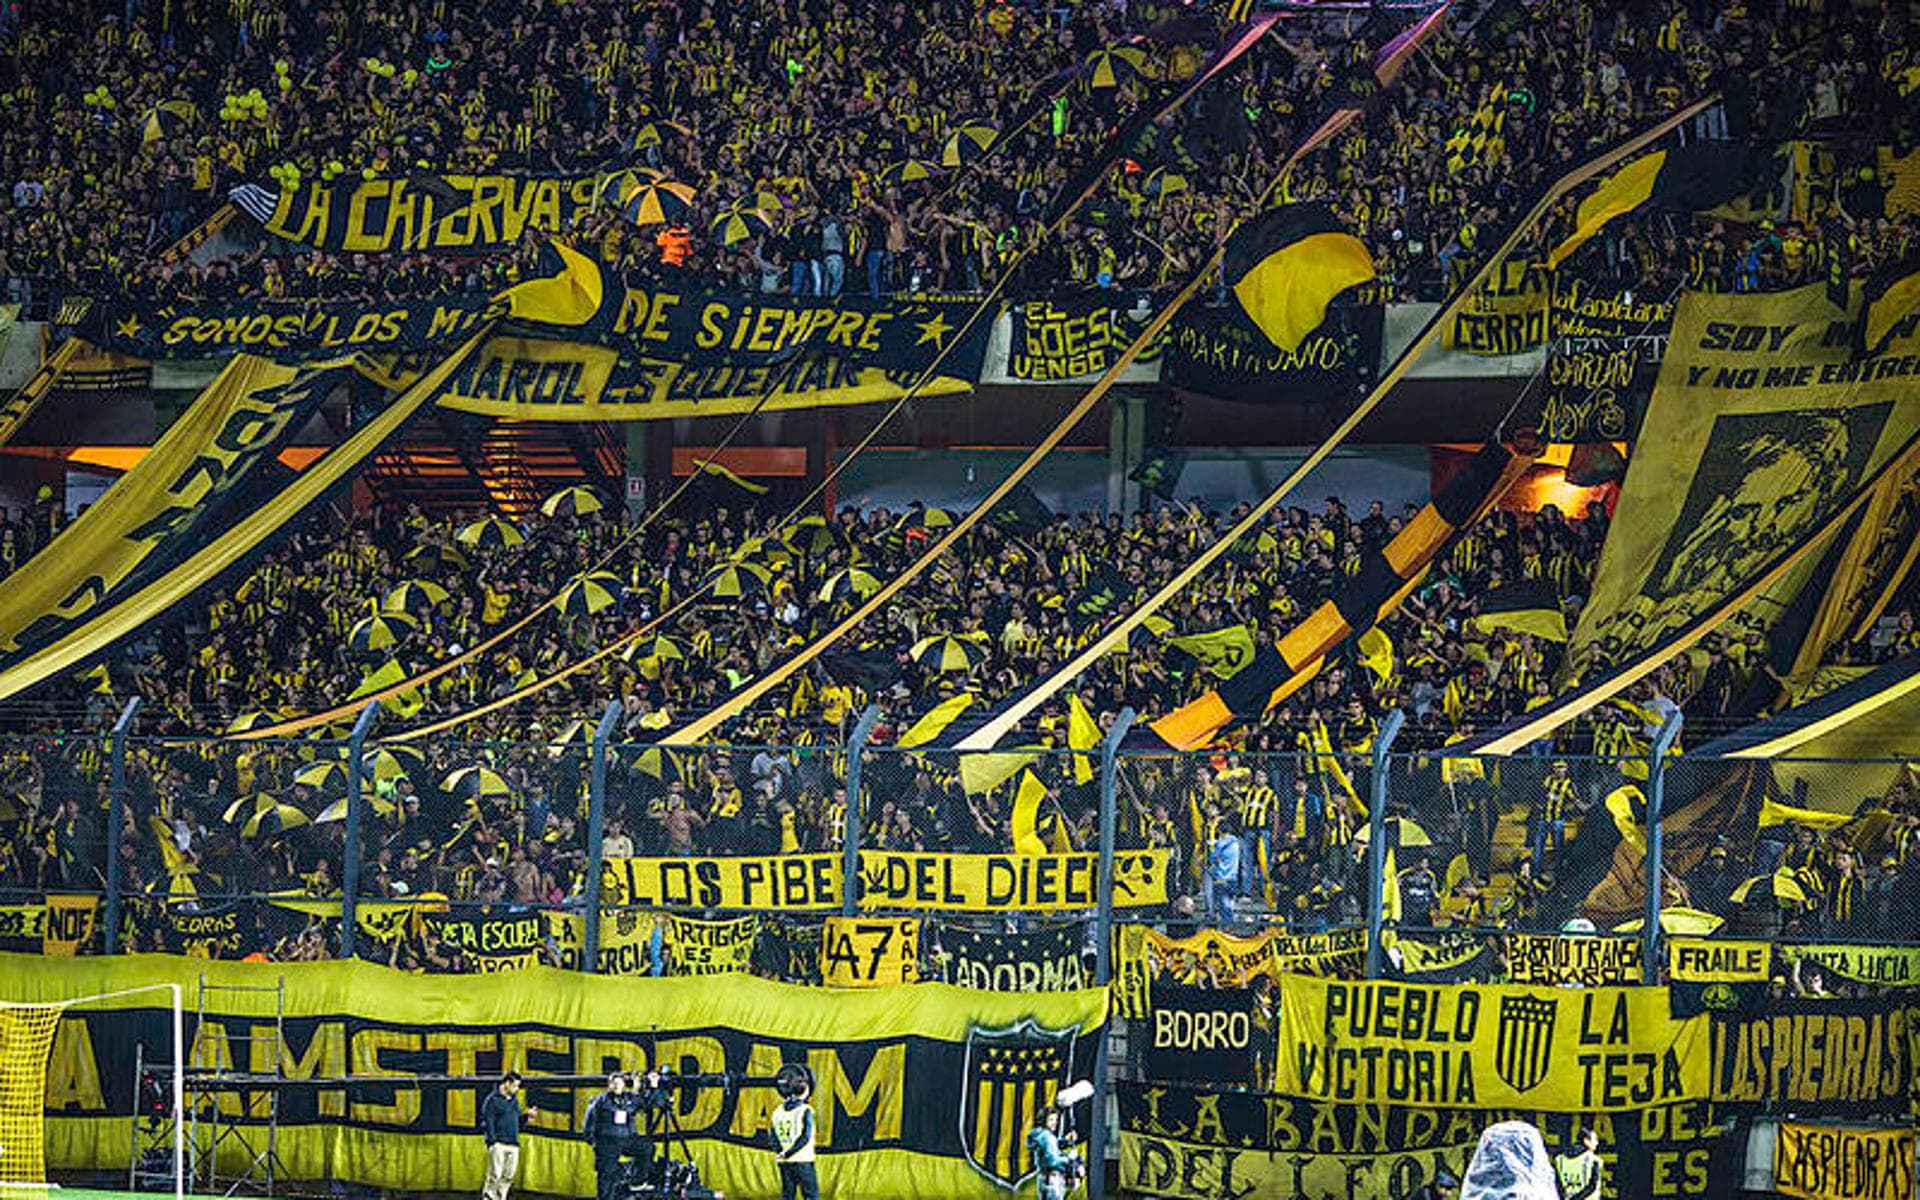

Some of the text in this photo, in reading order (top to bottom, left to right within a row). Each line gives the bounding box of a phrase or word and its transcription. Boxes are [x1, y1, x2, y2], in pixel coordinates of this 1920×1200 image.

[265, 182, 332, 248] LA
[321, 309, 409, 346] LOS
[614, 288, 680, 340] DE
[1026, 301, 1067, 320] EL
[1456, 311, 1544, 354] CERRO
[1699, 320, 1799, 351] SOY
[1687, 365, 1710, 387] Y
[1712, 366, 1759, 389] NO
[1762, 364, 1814, 388] ME
[625, 858, 723, 907] LOS
[887, 856, 966, 903] DEL
[685, 947, 712, 964] ES
[1678, 947, 1763, 973] FRAILE
[1154, 1009, 1250, 1053] BORRO
[1326, 984, 1481, 1043] PUEBLO
[1579, 991, 1630, 1045] LA
[184, 1021, 907, 1148] AMSTERDAM
[1299, 1042, 1476, 1104] VICTORIA
[1577, 1047, 1686, 1108] TEJA
[1141, 1087, 1229, 1147] LA
[1639, 1101, 1723, 1142] DEL
[1136, 1138, 1257, 1199] DEL
[1652, 1149, 1711, 1197] ES
